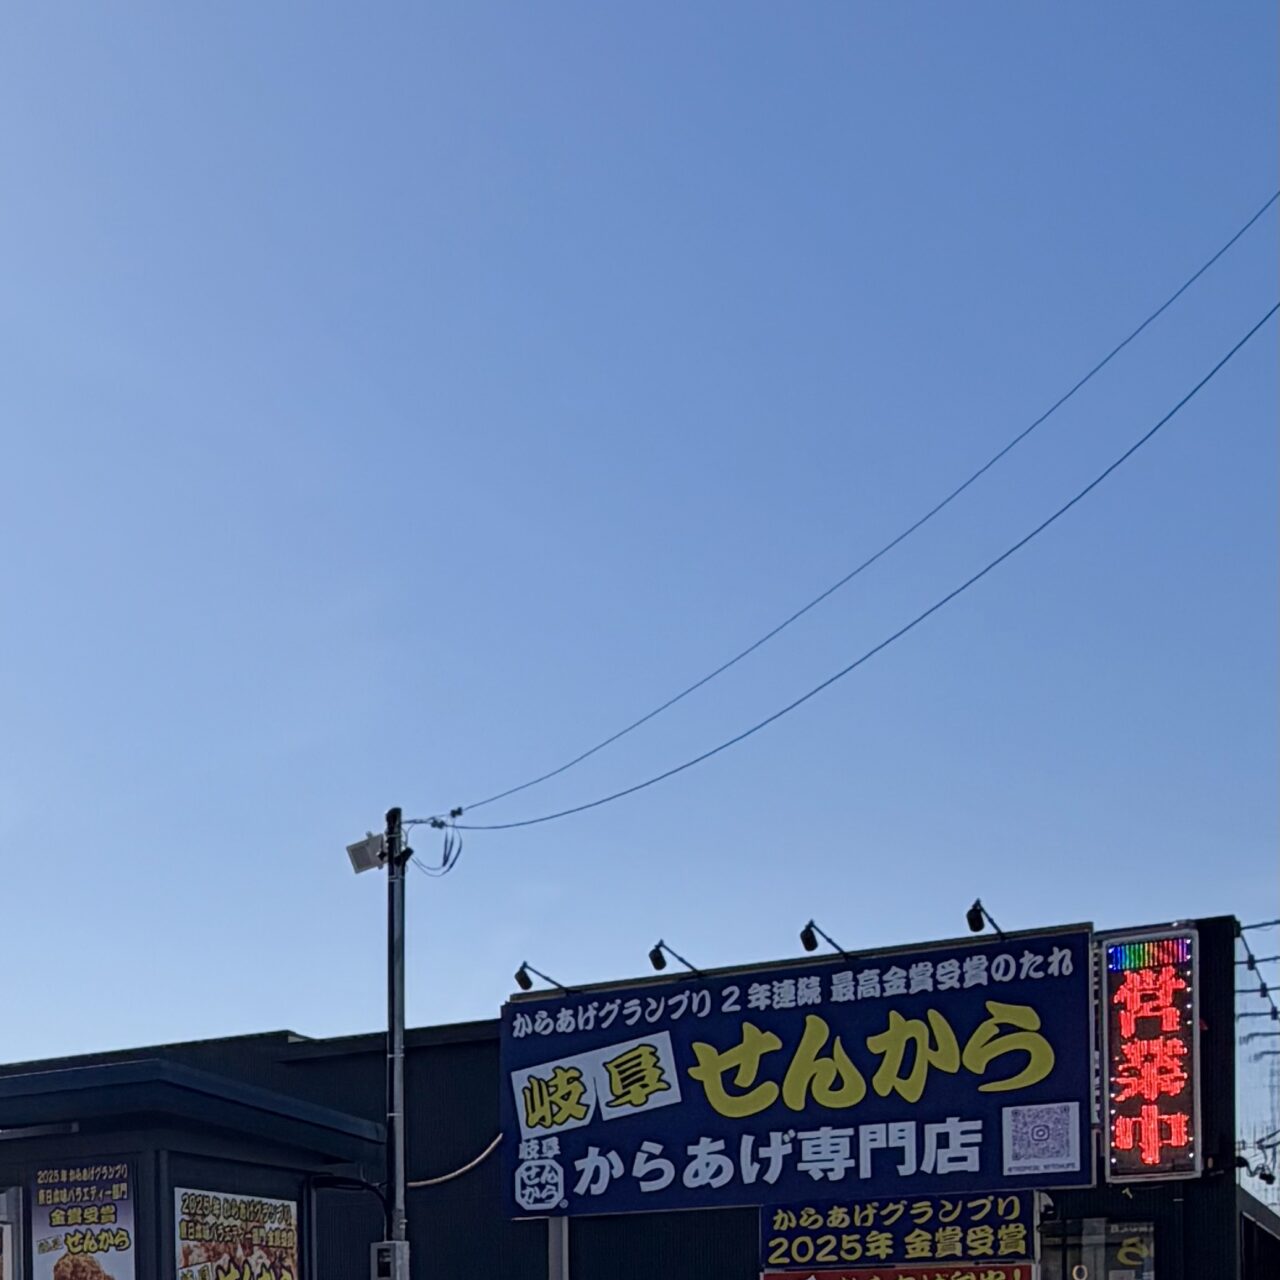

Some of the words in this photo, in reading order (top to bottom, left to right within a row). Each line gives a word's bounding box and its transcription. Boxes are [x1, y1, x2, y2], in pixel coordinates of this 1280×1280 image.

[512, 990, 711, 1038] からあげグランプリ
[830, 947, 1073, 1002] 最高金賞受賞のたれ
[522, 1044, 671, 1128] 岐阜
[687, 1001, 1055, 1118] せんから
[1114, 965, 1189, 1165] 営業中
[573, 1117, 983, 1196] からあげ専門店
[65, 1228, 131, 1253] せんから
[768, 1231, 894, 1264] 2025年
[904, 1223, 1027, 1259] 金賞受賞
[773, 1196, 1021, 1231] からあげグランプリ
